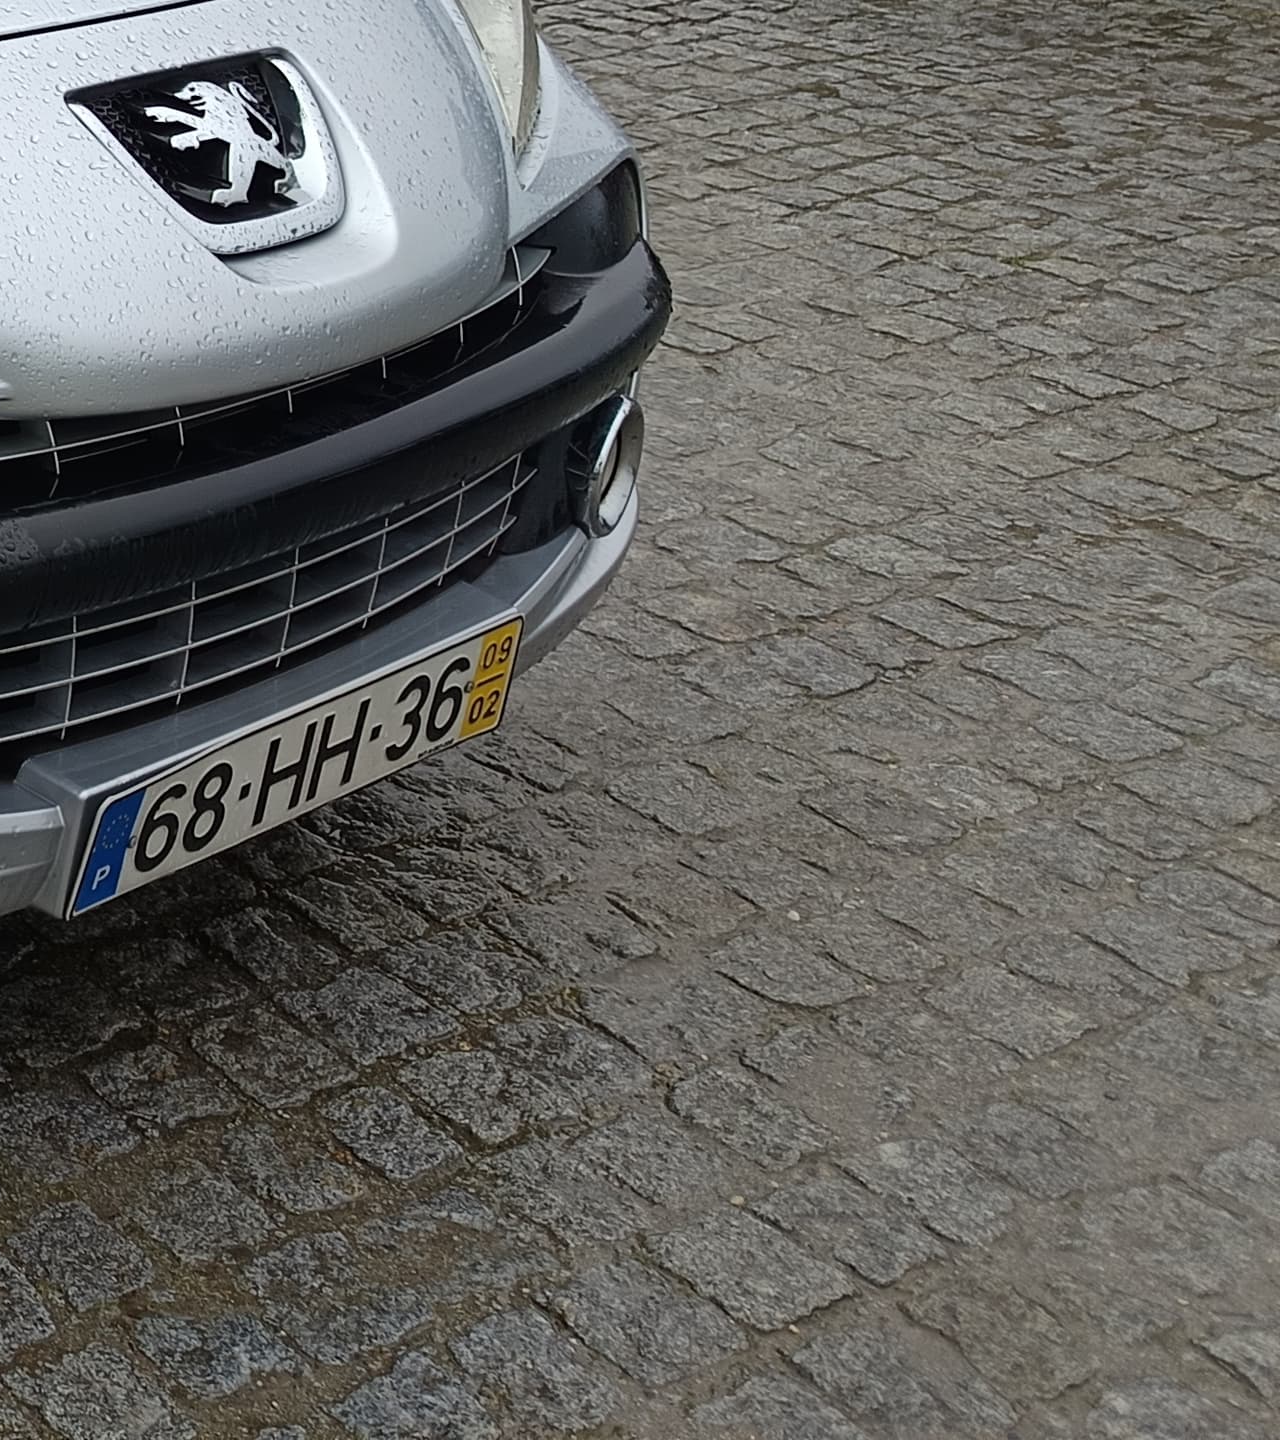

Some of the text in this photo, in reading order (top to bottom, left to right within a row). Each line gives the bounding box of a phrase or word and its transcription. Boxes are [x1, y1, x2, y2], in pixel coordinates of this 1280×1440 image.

[483, 635, 513, 669] 09
[468, 689, 501, 725] 02
[92, 864, 111, 891] P
